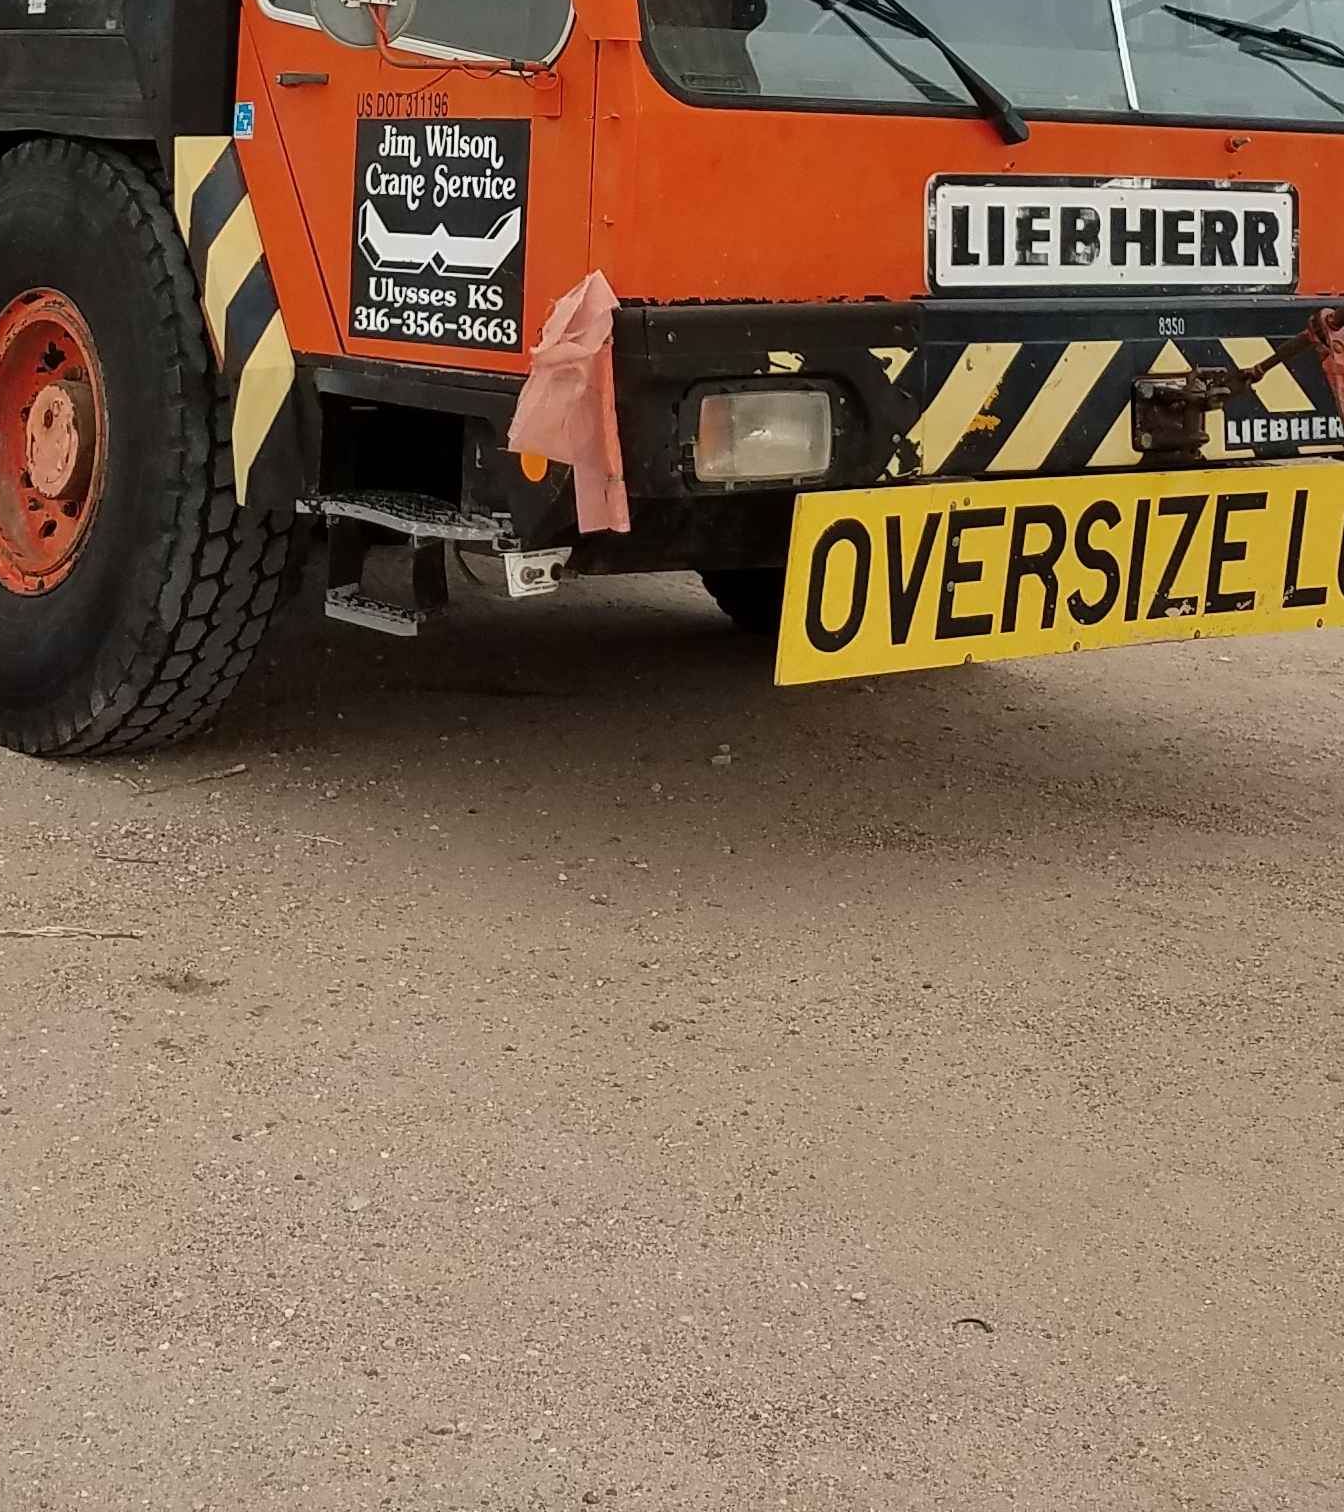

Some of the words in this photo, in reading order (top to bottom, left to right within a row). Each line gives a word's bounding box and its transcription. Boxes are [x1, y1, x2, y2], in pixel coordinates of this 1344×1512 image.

[357, 92, 373, 117] US
[377, 92, 402, 117] DOT
[406, 92, 448, 117] 311196
[379, 125, 421, 168] Jim
[425, 125, 504, 169] Wilson
[365, 163, 425, 210] Crane
[433, 164, 517, 207] Service
[951, 205, 1280, 266] LIEBHERR
[369, 277, 456, 307] Ulysses
[468, 285, 503, 311] KS
[354, 306, 518, 345] 316-356-3663
[1158, 316, 1185, 335] 8350
[804, 491, 1267, 653] OVERSIZE
